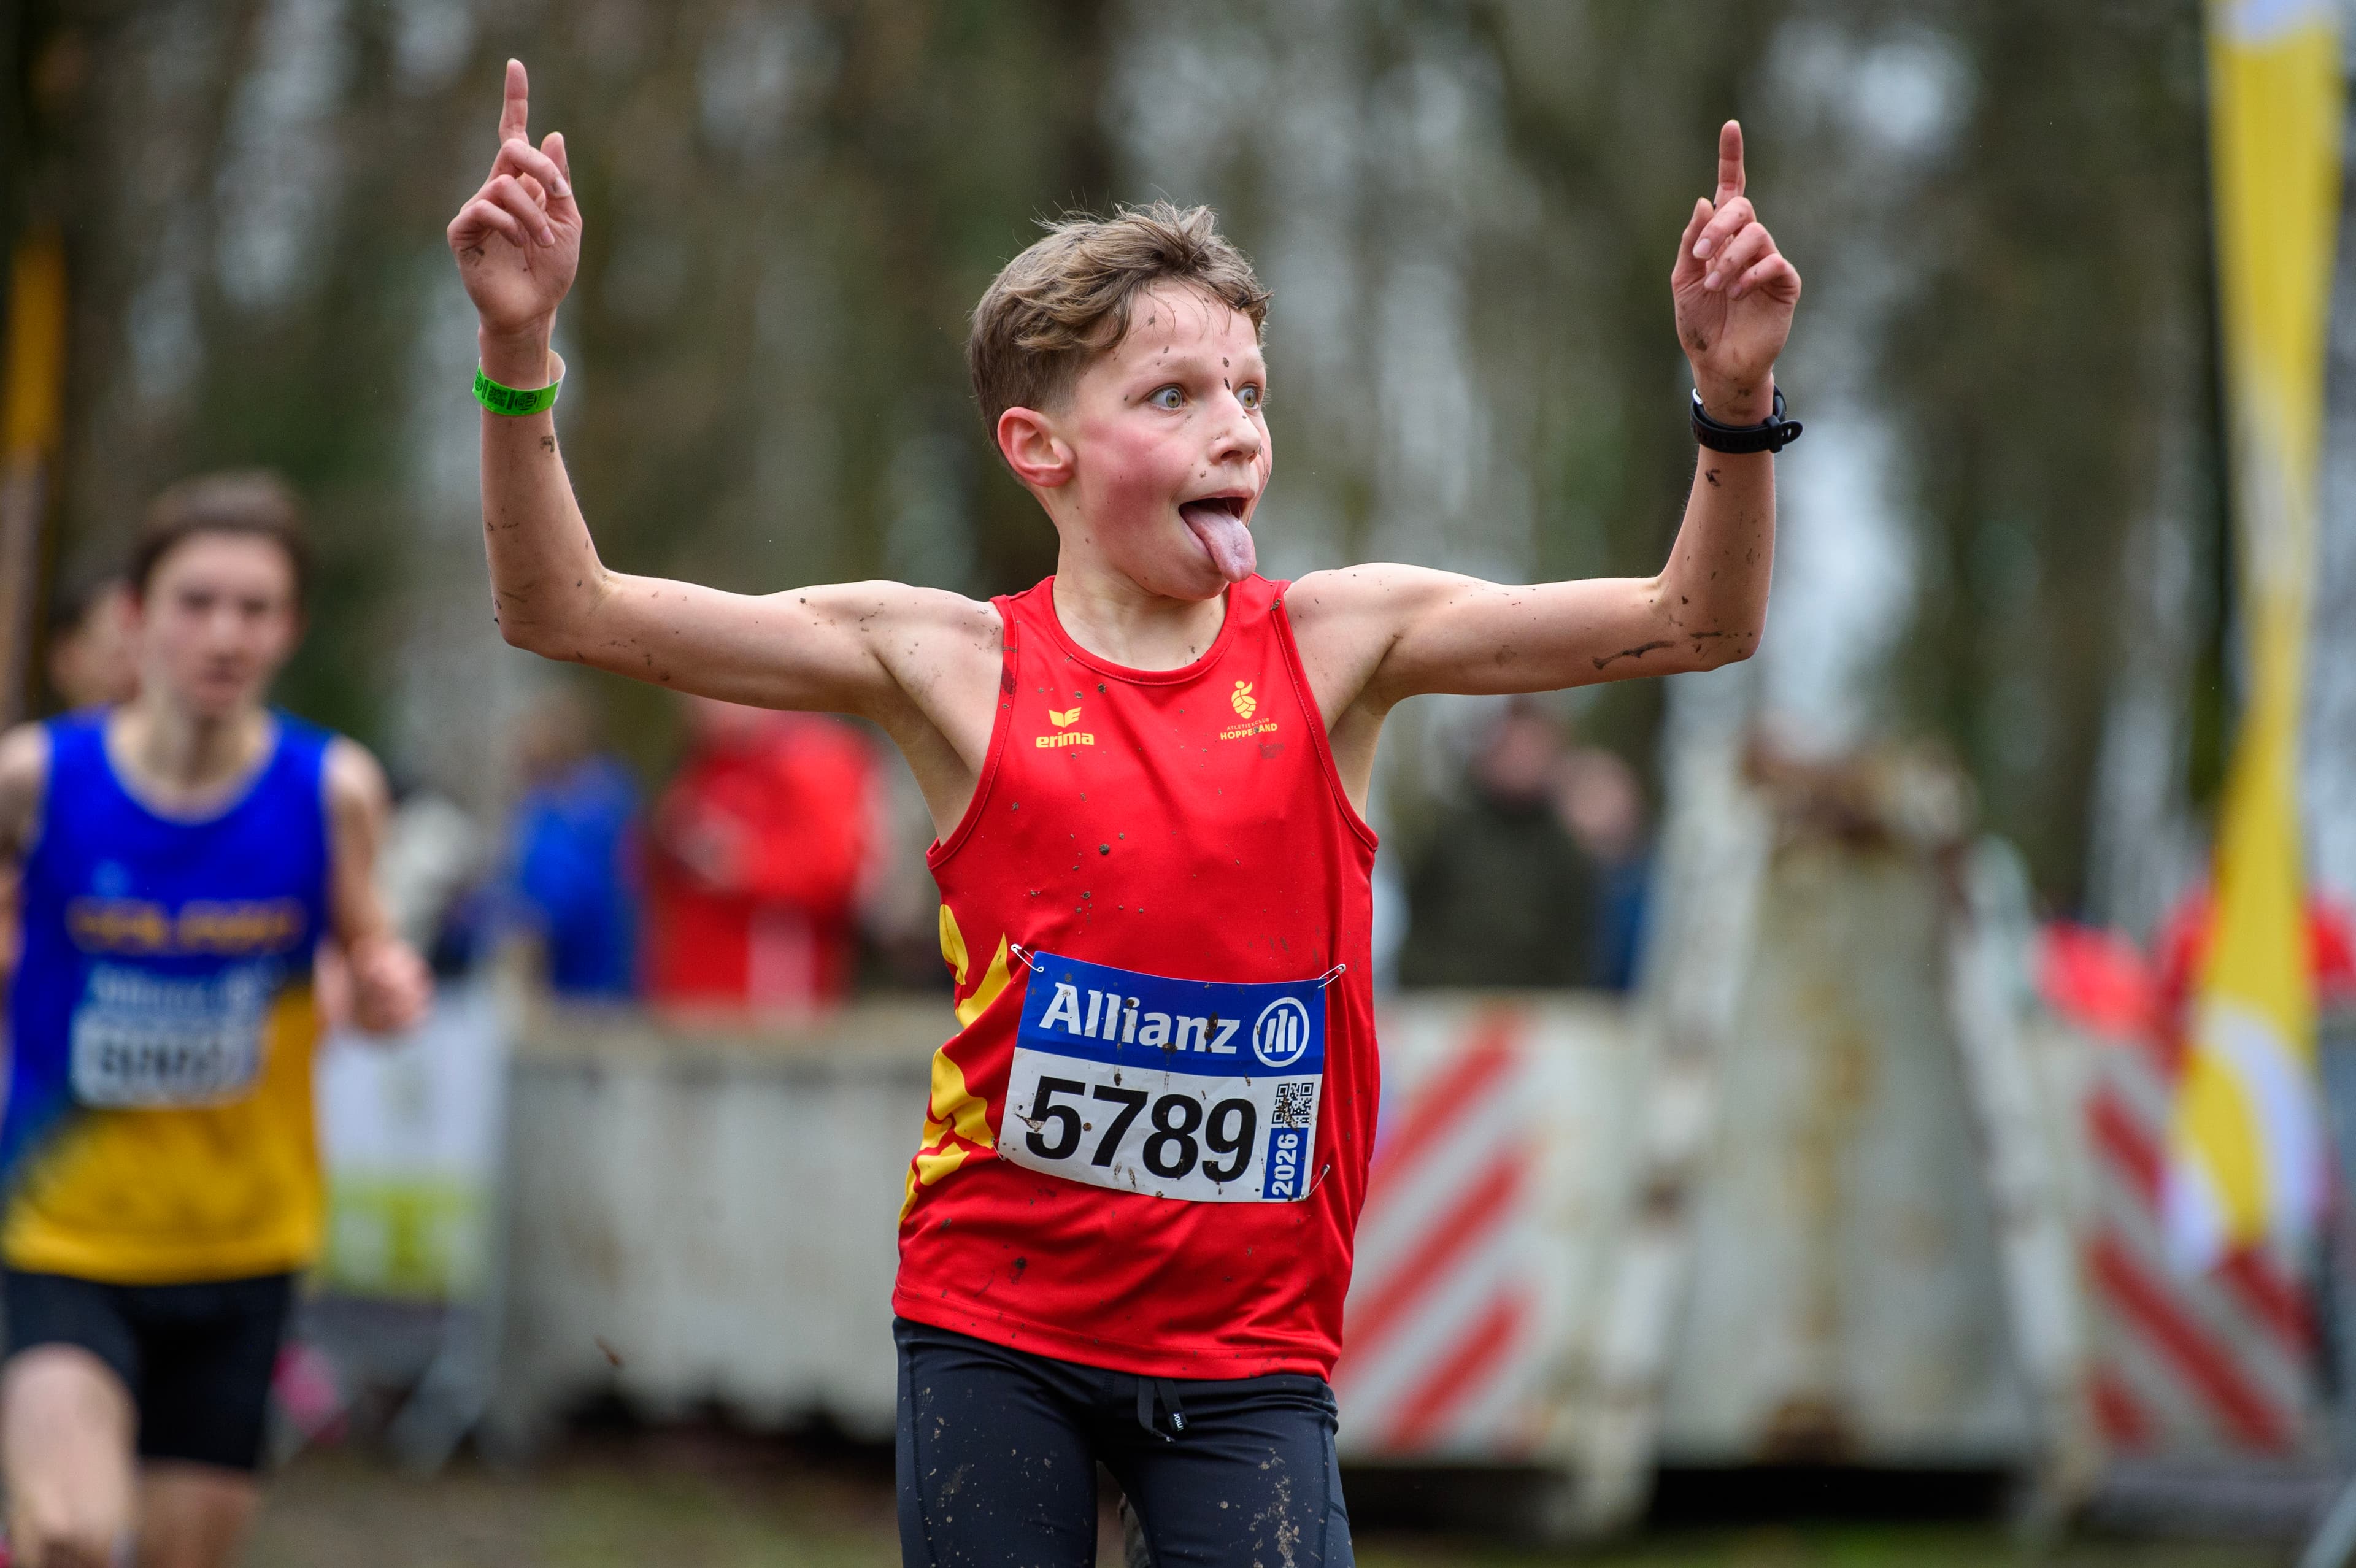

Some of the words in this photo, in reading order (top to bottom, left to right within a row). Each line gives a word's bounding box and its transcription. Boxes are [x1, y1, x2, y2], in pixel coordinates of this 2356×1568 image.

[1036, 731, 1095, 748] erima
[1227, 718, 1269, 730] ATLETIEKCLUB
[1039, 982, 1240, 1054] Allianz
[1025, 1075, 1257, 1182] 5789
[1271, 1133, 1298, 1197] 2026
